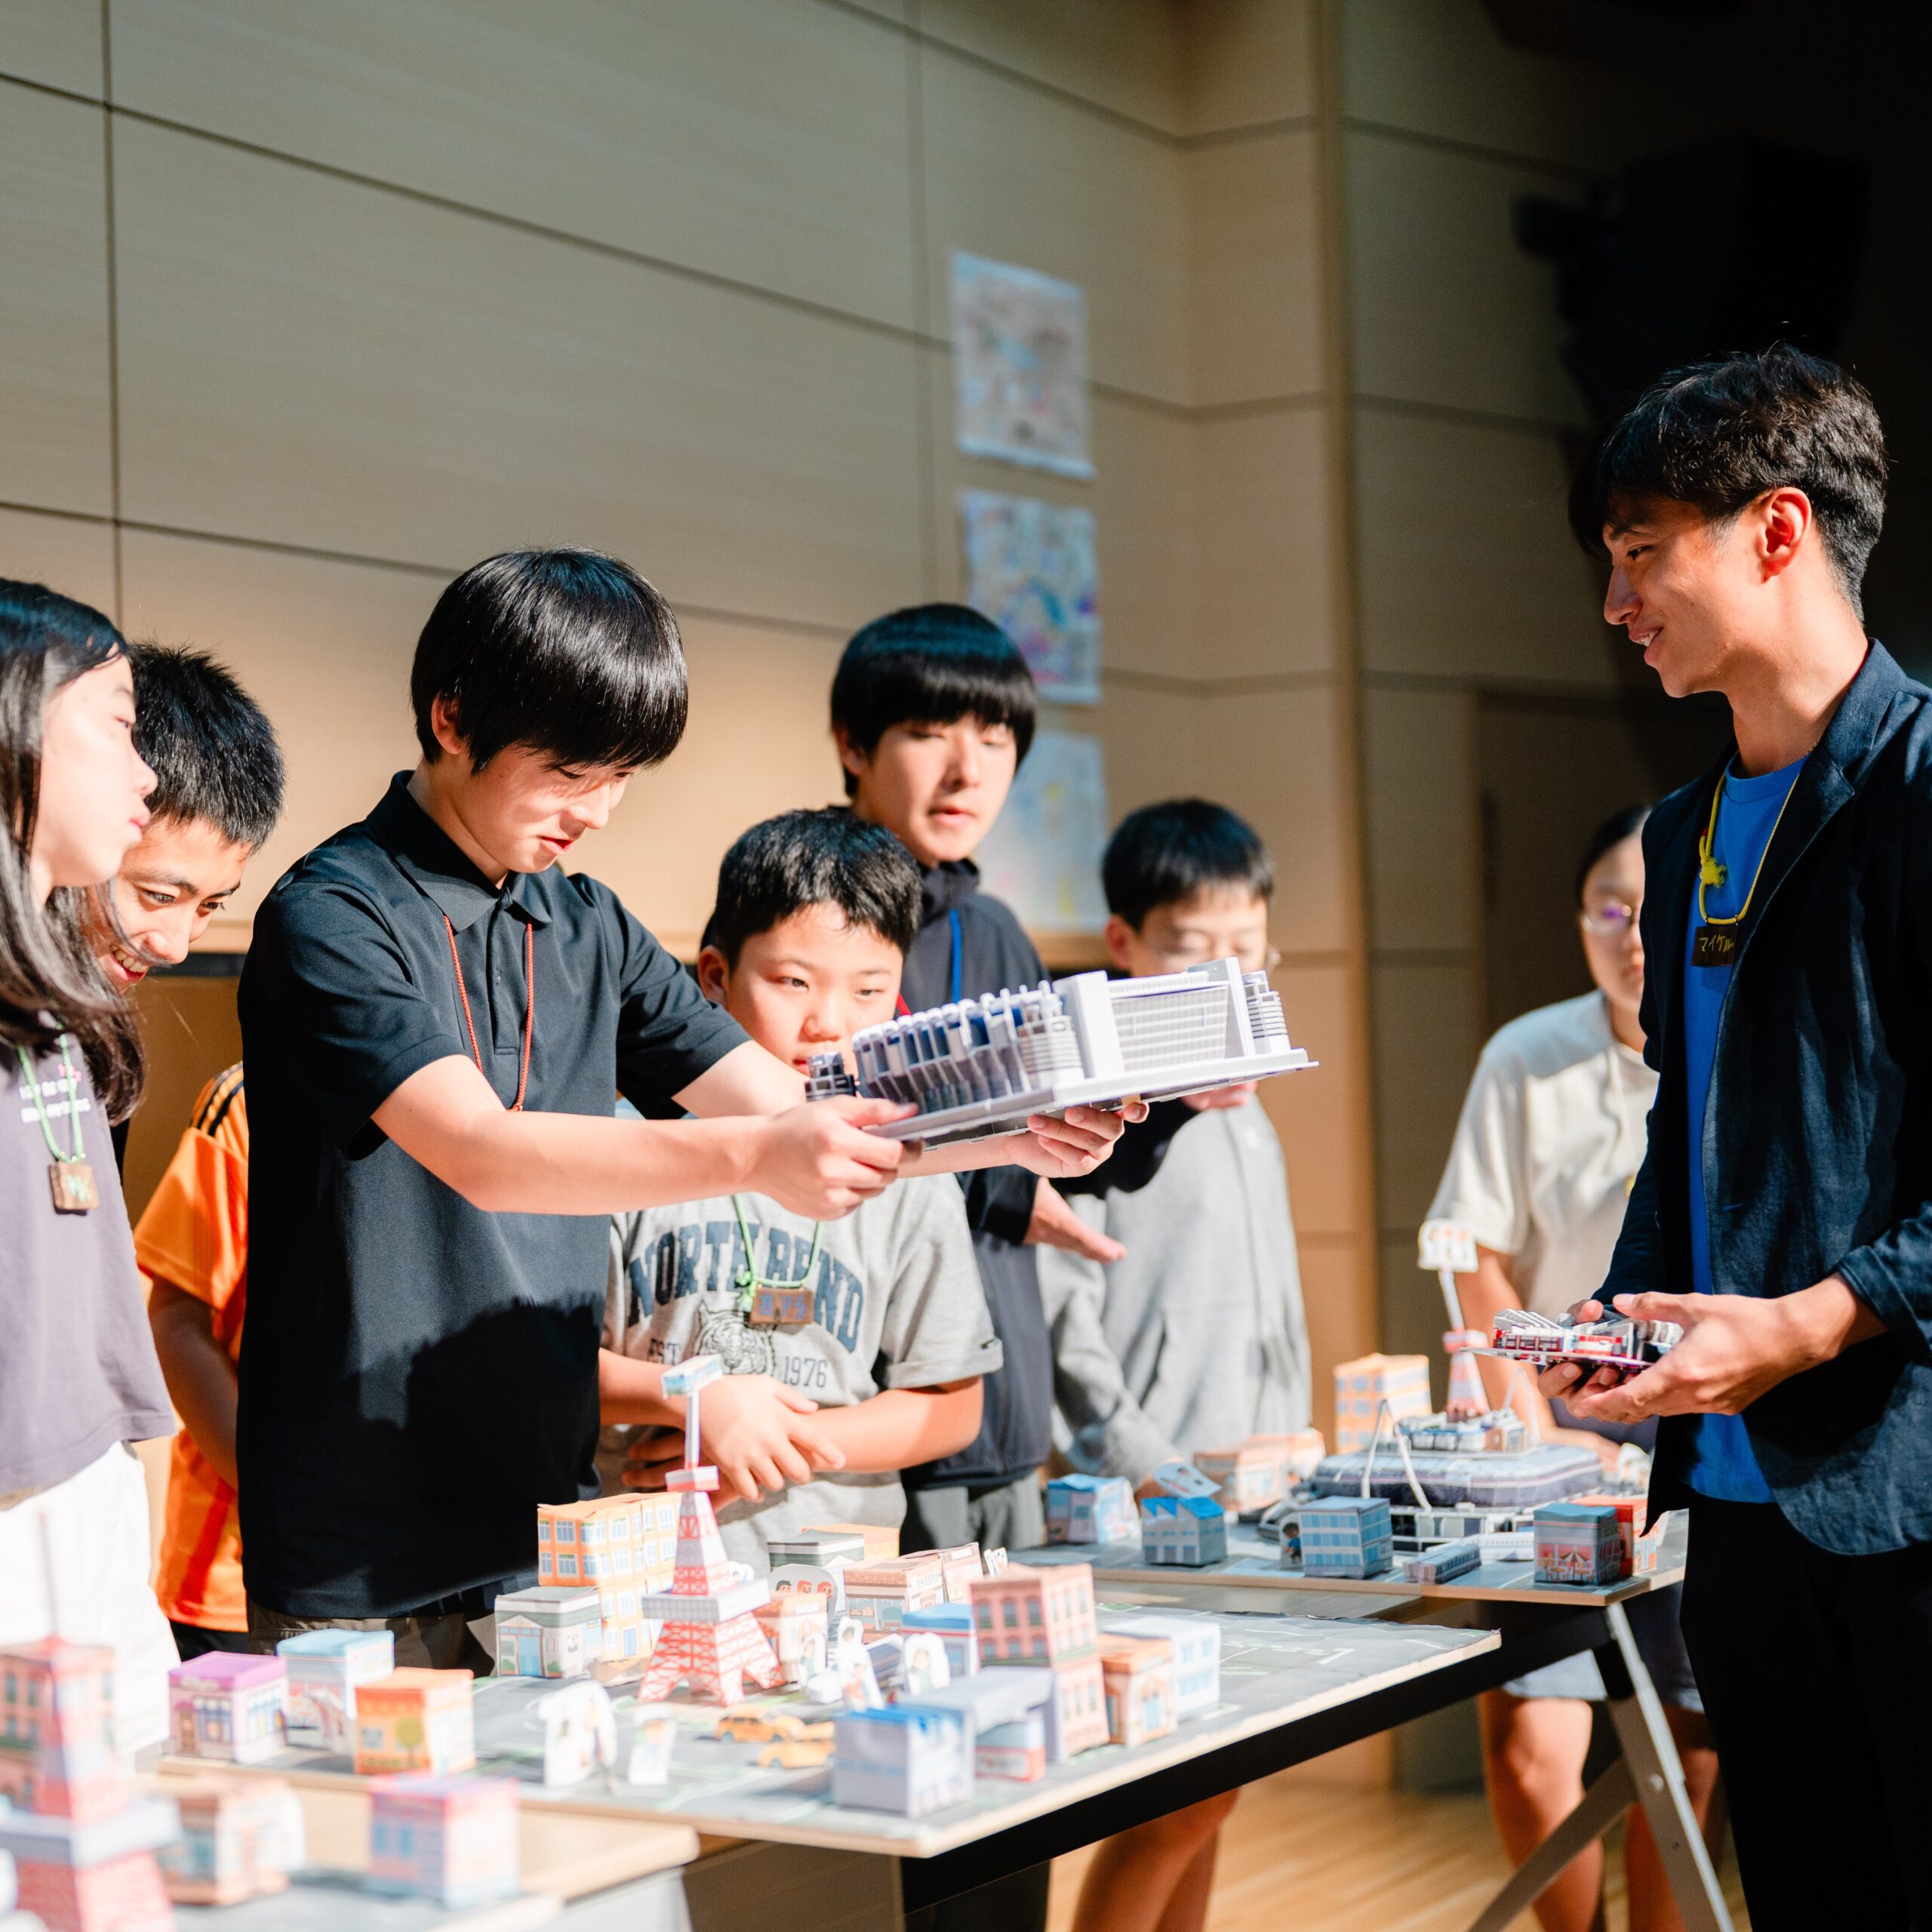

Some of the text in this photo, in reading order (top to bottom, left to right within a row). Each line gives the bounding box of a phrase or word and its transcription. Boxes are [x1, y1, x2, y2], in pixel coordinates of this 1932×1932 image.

[1699, 934, 1734, 952] マイケル
[628, 1221, 863, 1353] NORTH BEND
[784, 1355, 828, 1388] 1976
